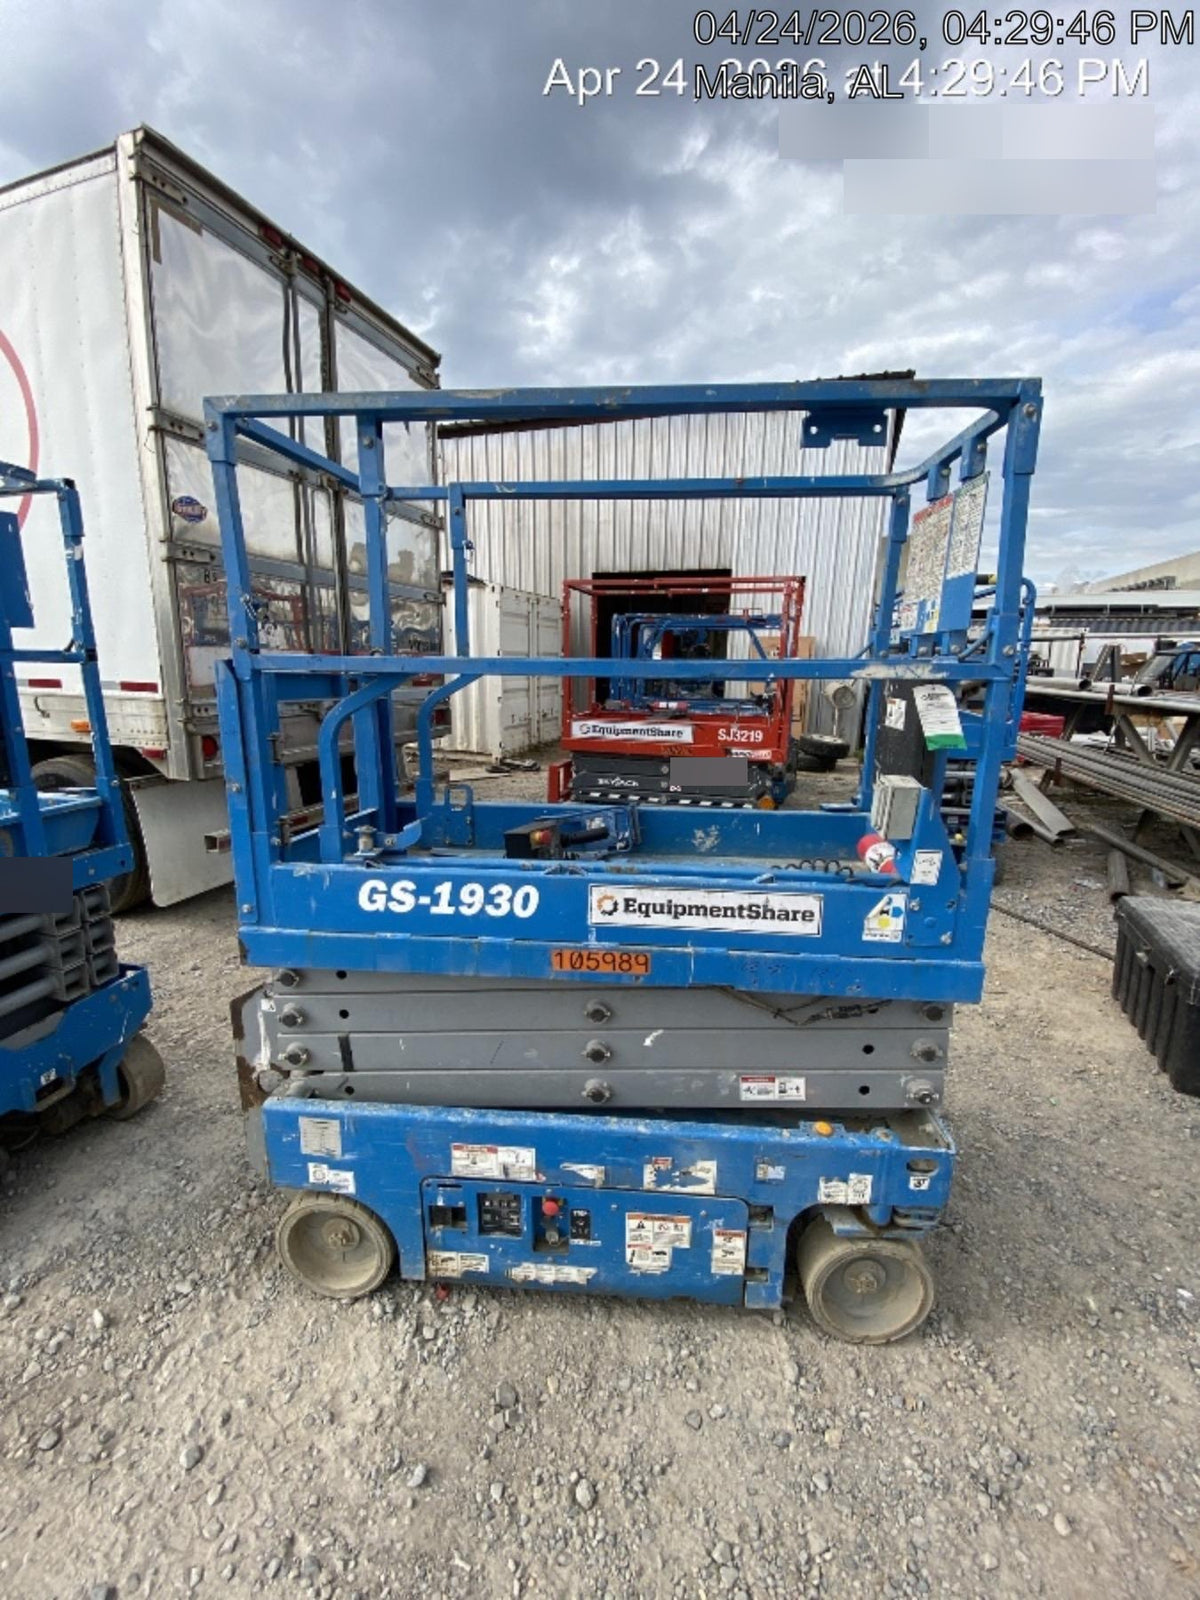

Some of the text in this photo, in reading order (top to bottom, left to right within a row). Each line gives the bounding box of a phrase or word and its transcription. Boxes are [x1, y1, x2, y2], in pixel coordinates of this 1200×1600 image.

[592, 724, 684, 738] EquipmentShare
[717, 728, 763, 742] SJ3219
[358, 879, 540, 918] GS-1930
[622, 897, 815, 923] EquipmentShare
[554, 951, 648, 973] 105989
